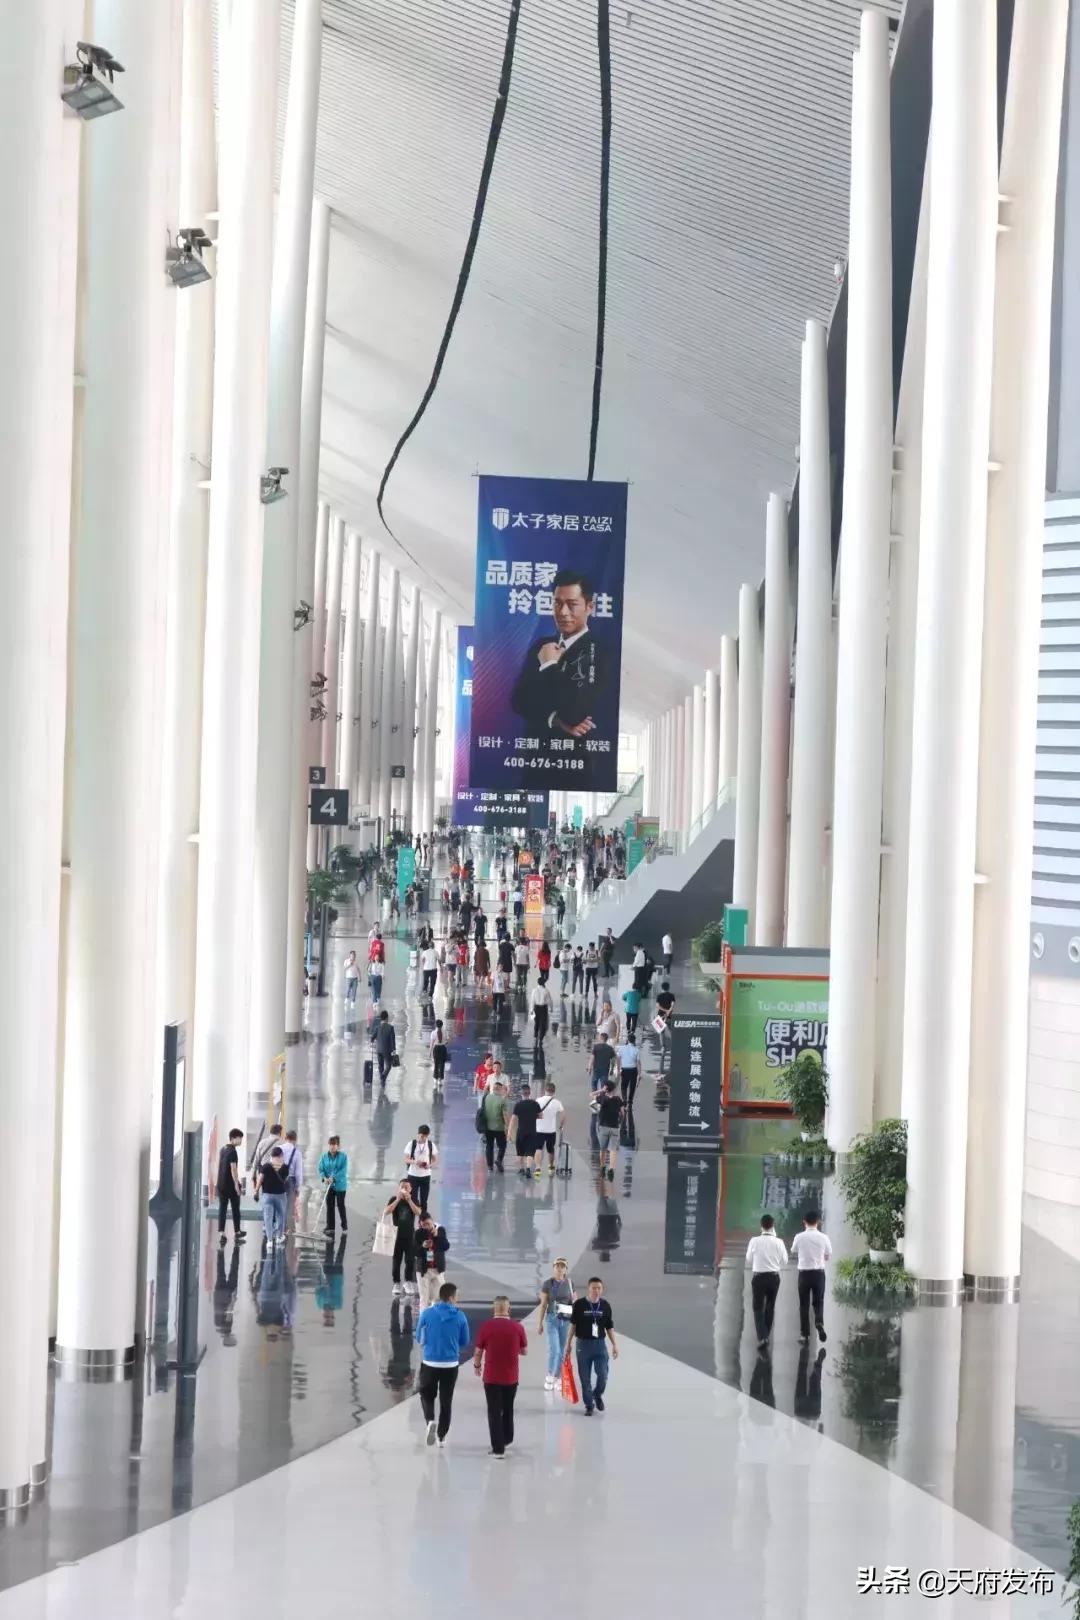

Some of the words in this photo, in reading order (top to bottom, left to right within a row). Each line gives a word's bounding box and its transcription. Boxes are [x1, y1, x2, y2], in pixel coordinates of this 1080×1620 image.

[512, 513, 579, 531] 太子家居
[583, 515, 612, 525] TAIZI
[582, 524, 612, 533] CASA
[485, 560, 558, 587] 品质家
[503, 757, 584, 770] 400-676-3188
[312, 770, 320, 781] 3
[394, 768, 402, 776] 2
[320, 797, 337, 817] 4
[473, 805, 527, 814] 400-676-3188
[688, 1036, 703, 1117] 纵连展会物流
